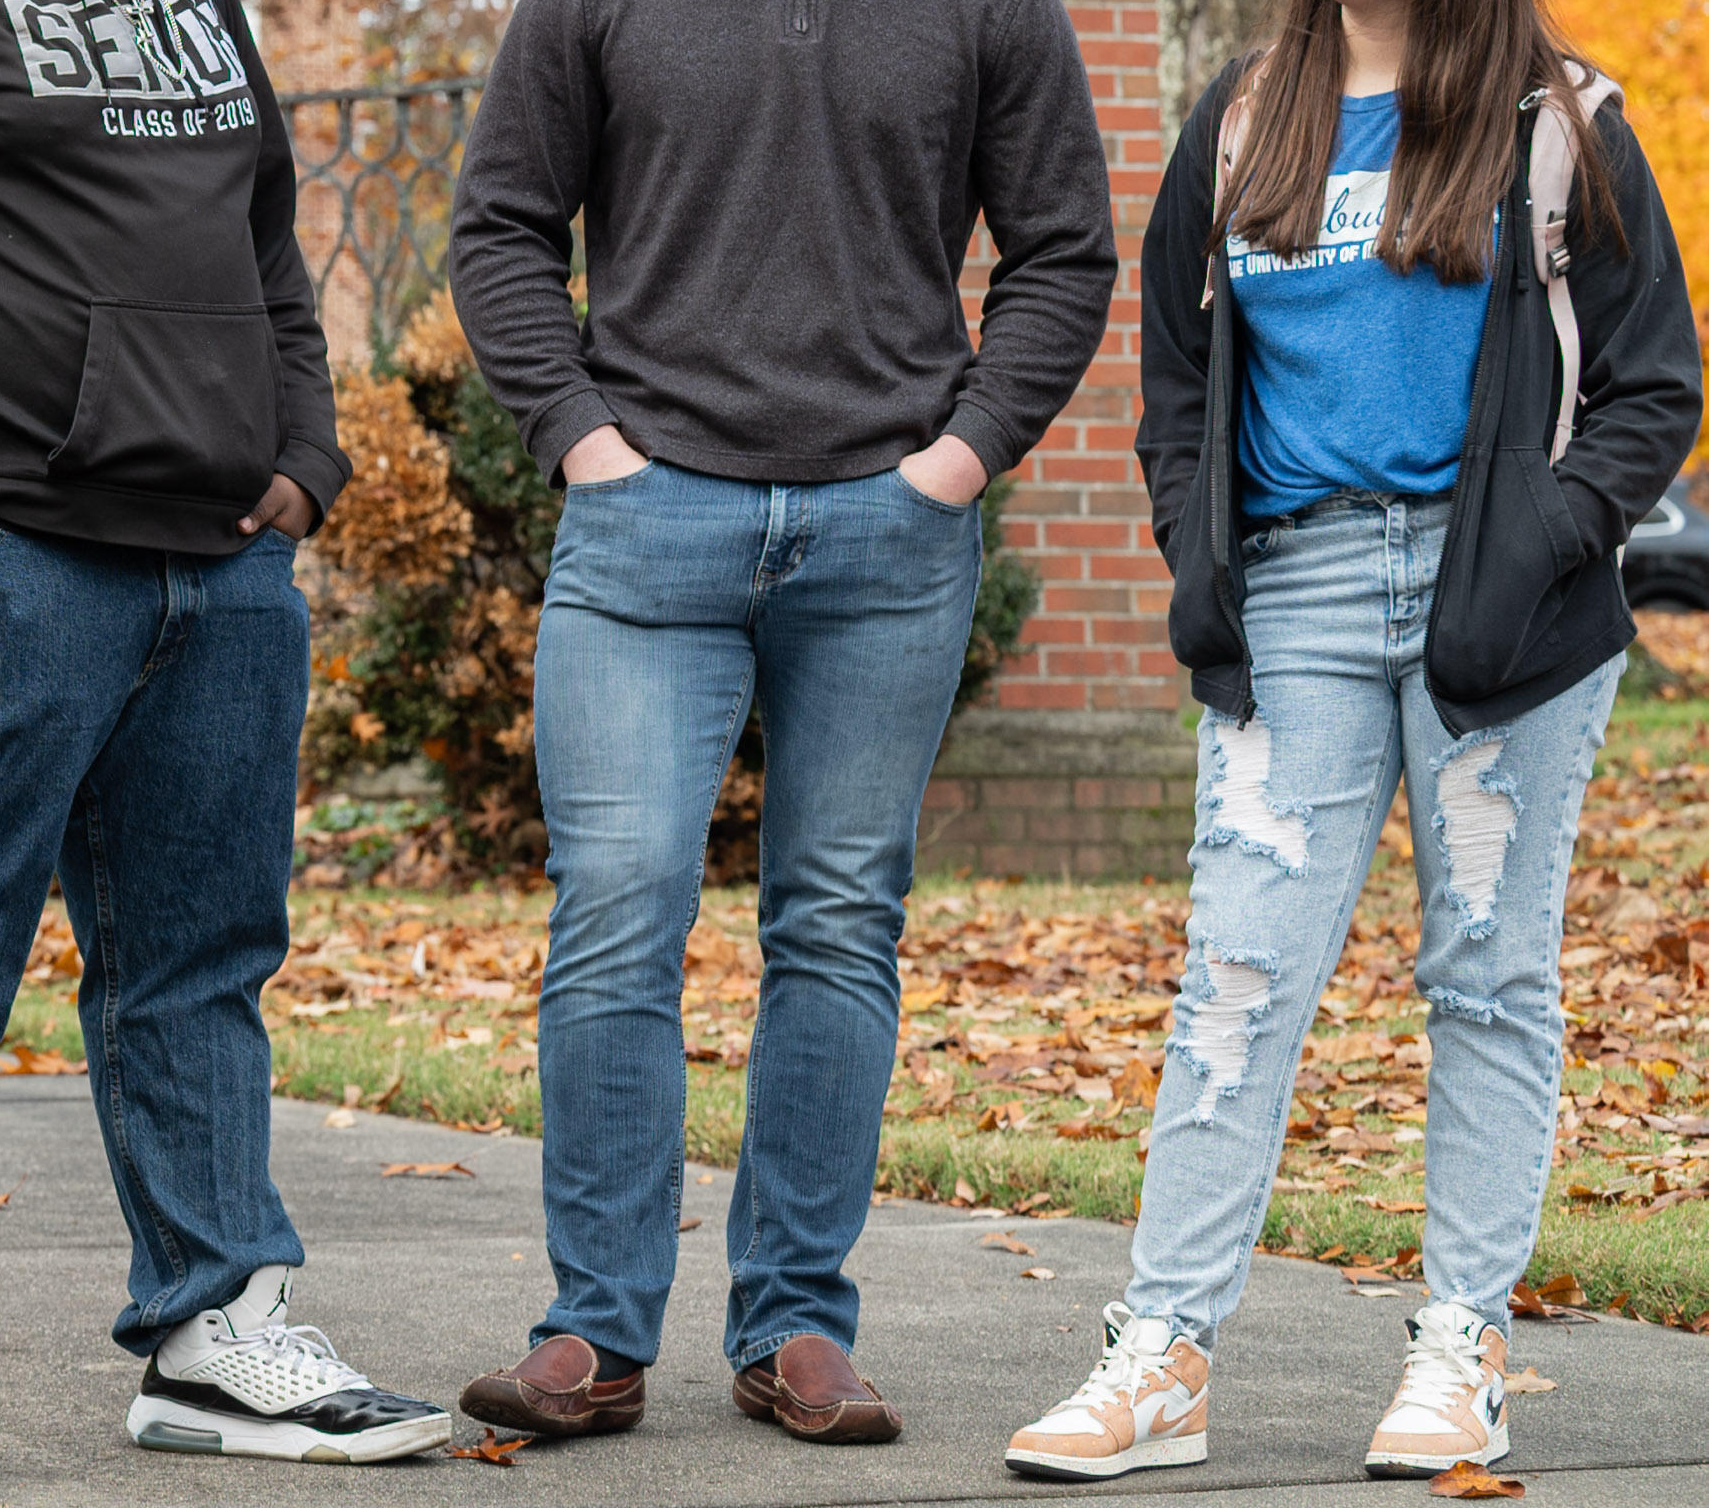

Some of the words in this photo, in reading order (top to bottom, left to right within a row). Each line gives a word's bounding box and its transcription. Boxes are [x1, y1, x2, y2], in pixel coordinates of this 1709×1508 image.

[102, 107, 177, 137] CLASS
[183, 108, 207, 136] OF
[214, 97, 255, 131] 2019
[1340, 245, 1360, 263] OF
